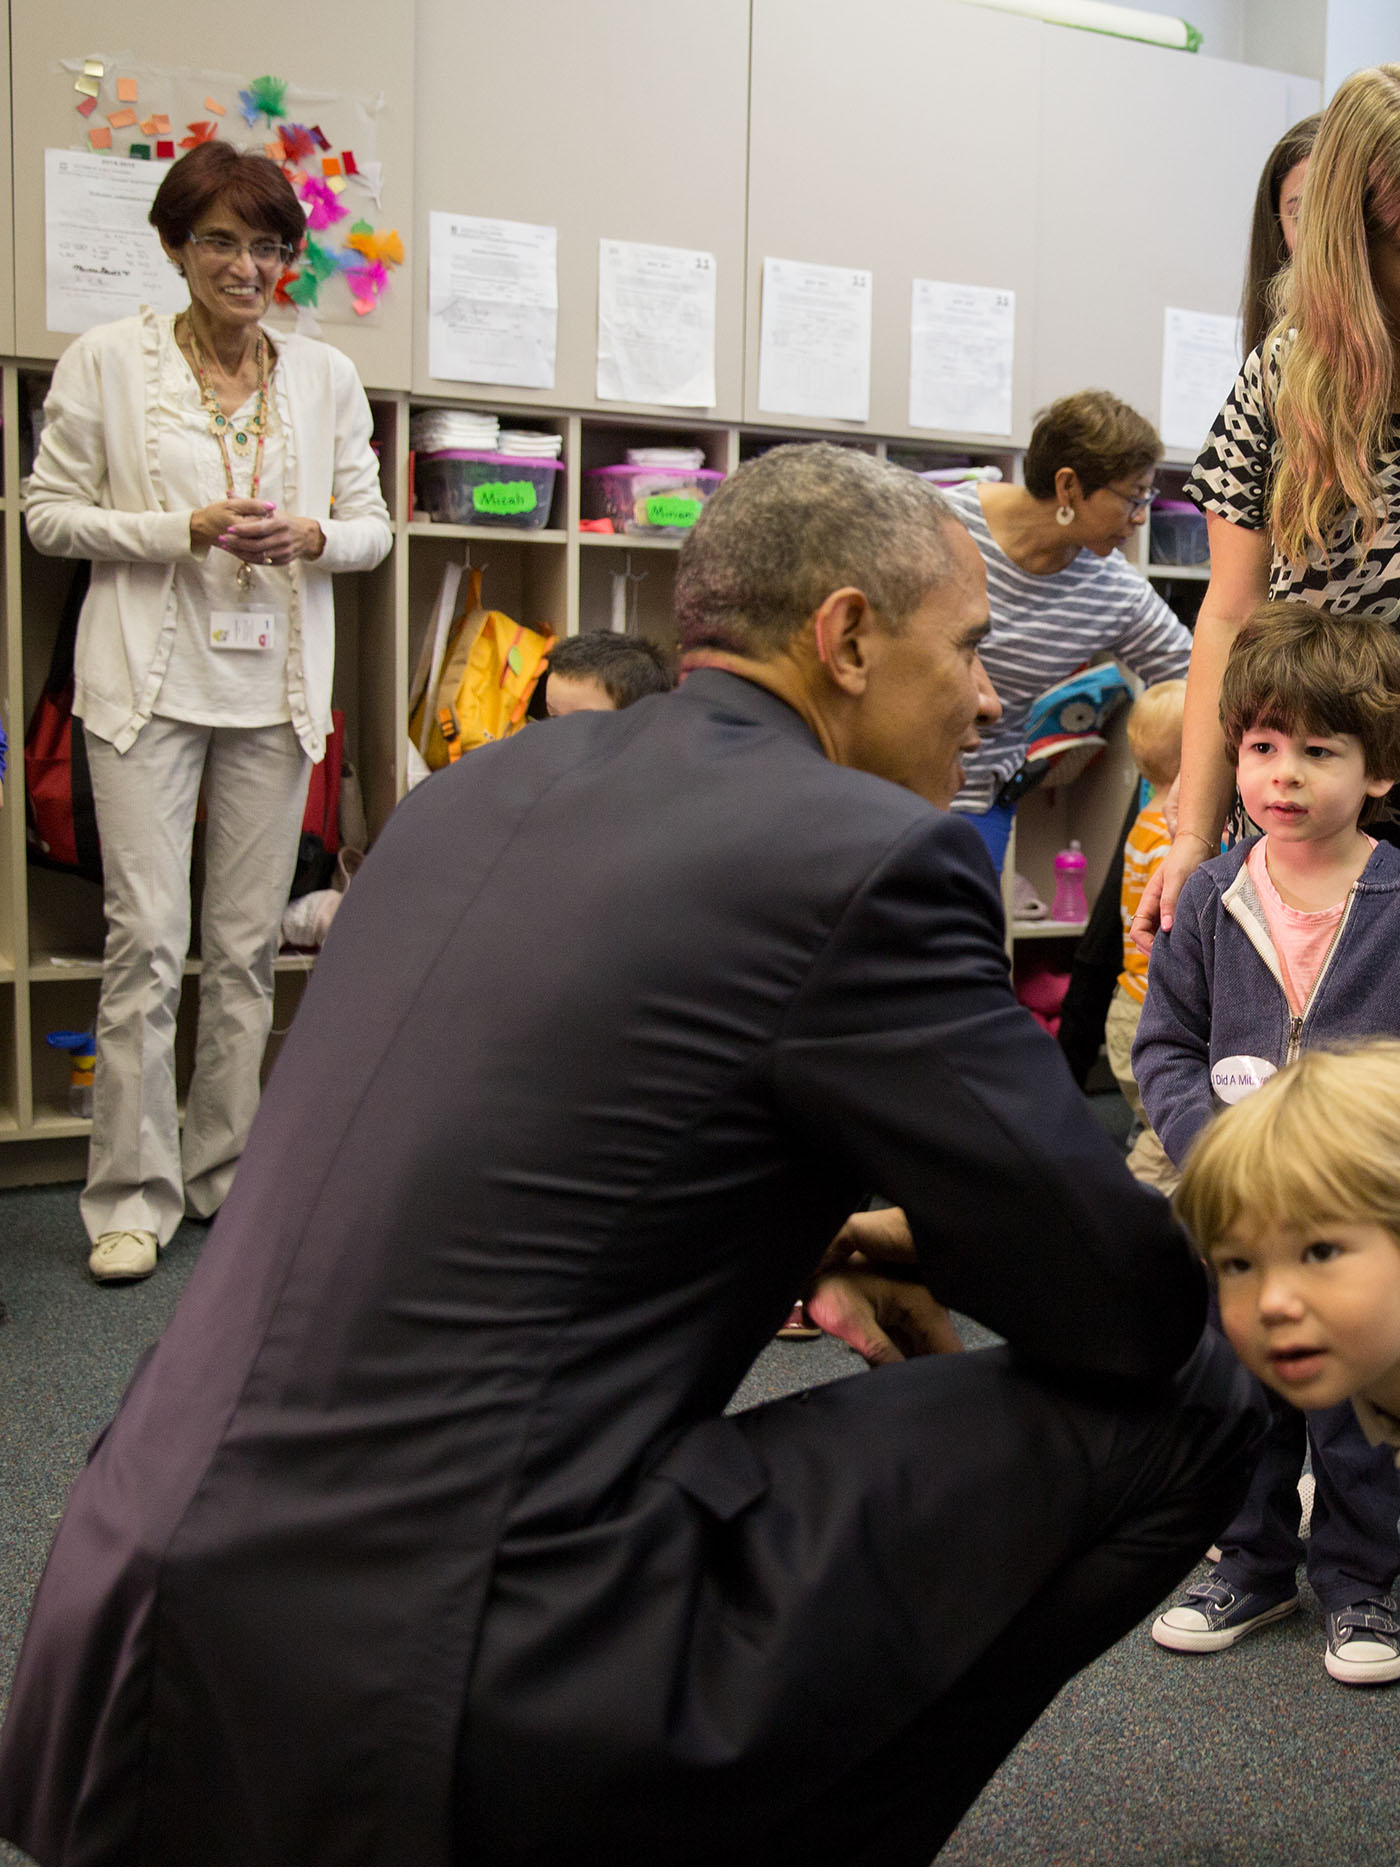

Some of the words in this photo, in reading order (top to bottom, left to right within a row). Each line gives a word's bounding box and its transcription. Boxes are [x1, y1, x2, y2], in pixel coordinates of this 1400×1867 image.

[480, 492, 525, 506] Micah
[651, 506, 695, 520] Miriam
[1215, 1074, 1229, 1086] Did
[1230, 1074, 1237, 1086] A
